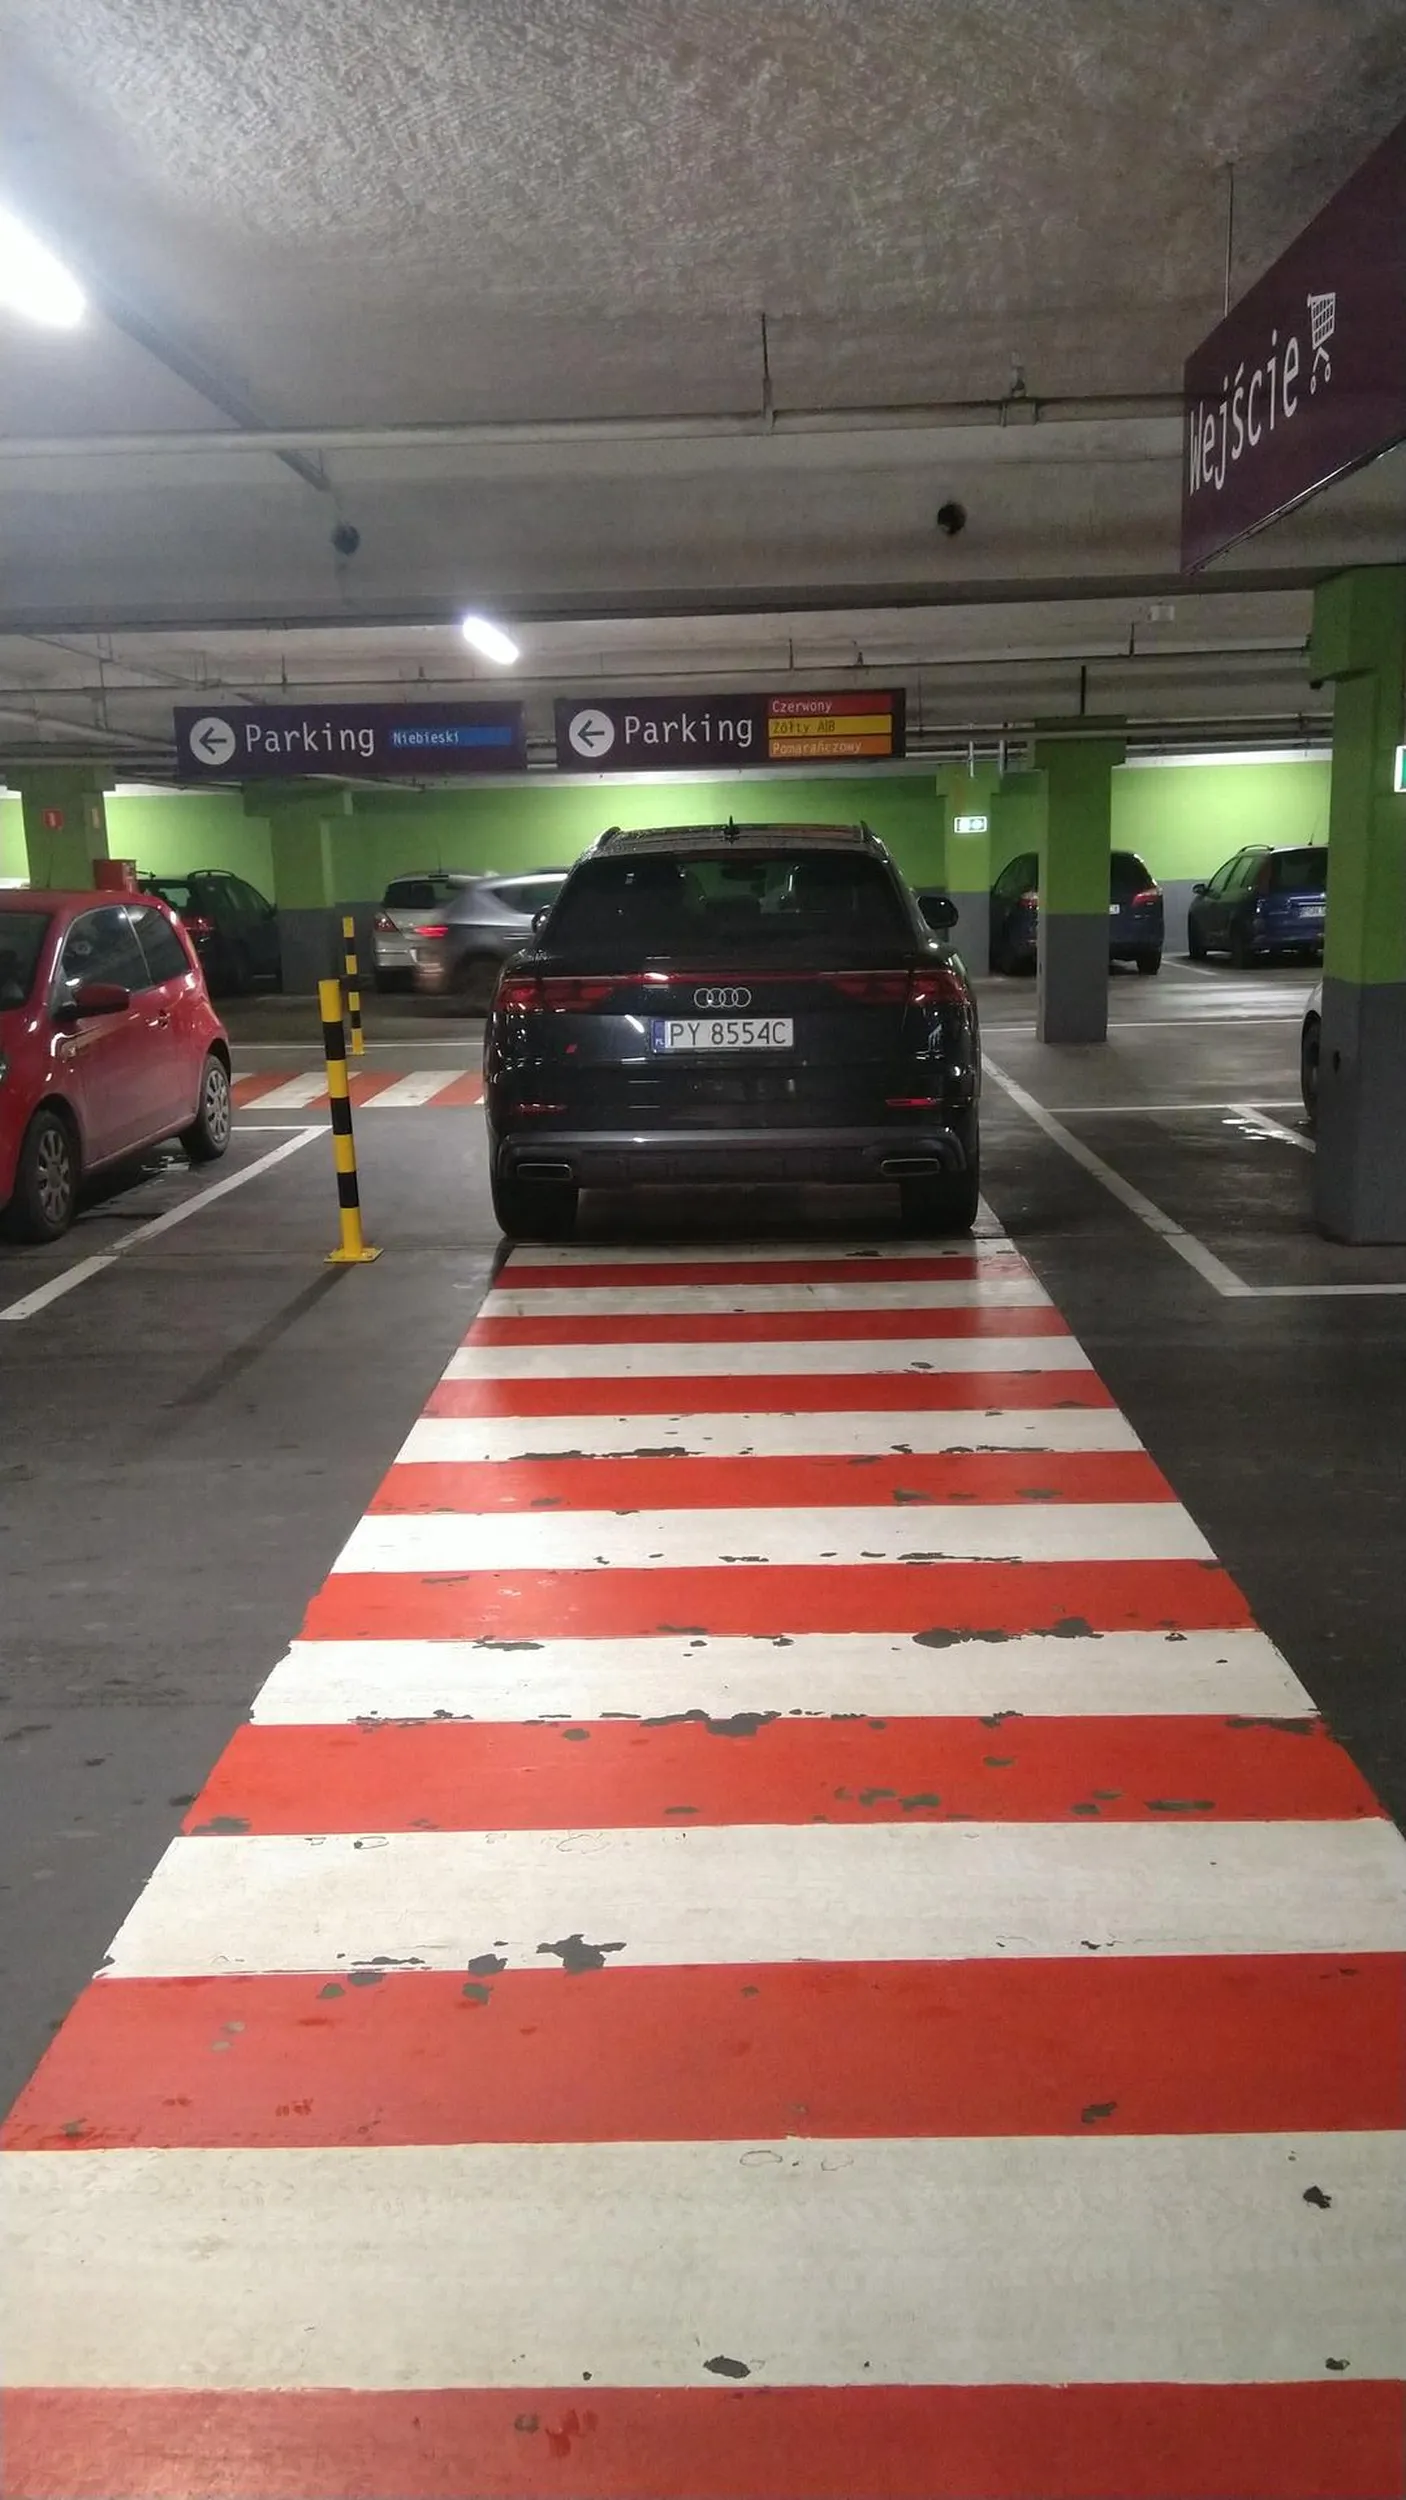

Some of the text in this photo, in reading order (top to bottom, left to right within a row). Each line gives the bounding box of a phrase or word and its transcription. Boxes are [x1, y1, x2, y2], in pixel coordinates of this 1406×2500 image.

[1189, 328, 1300, 496] Wejście
[772, 699, 833, 713] Czerwony
[245, 721, 375, 757] Parking
[393, 729, 460, 745] Niebieski
[624, 712, 753, 748] Parking
[670, 1021, 787, 1046] PY 8554C
